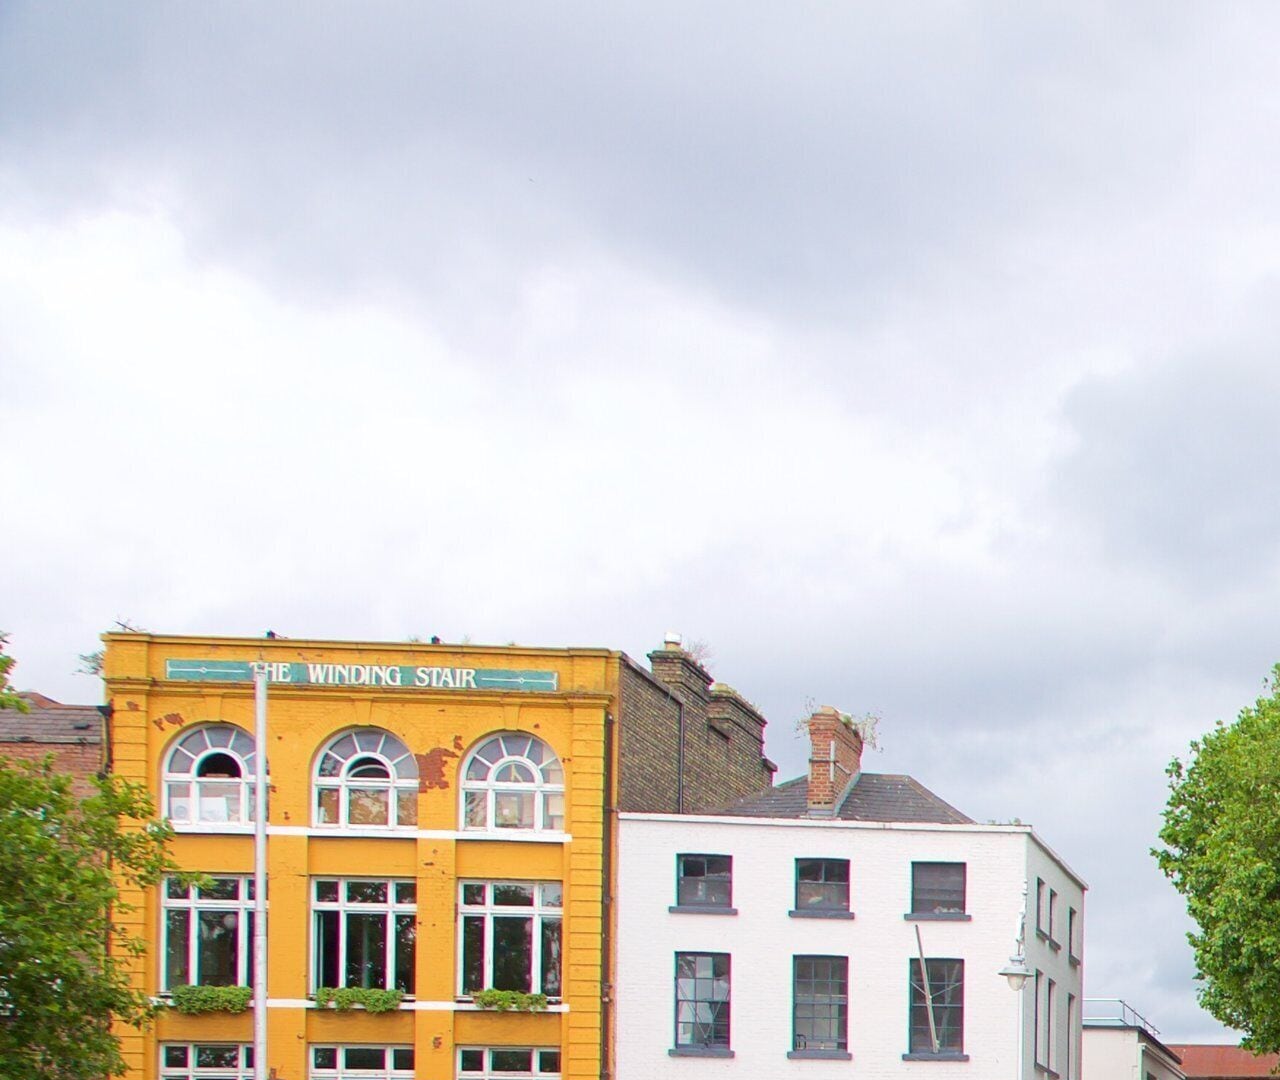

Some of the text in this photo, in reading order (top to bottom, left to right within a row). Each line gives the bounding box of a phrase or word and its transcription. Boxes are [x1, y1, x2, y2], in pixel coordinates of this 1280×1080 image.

[248, 662, 478, 689] THE WINDING STAIR
